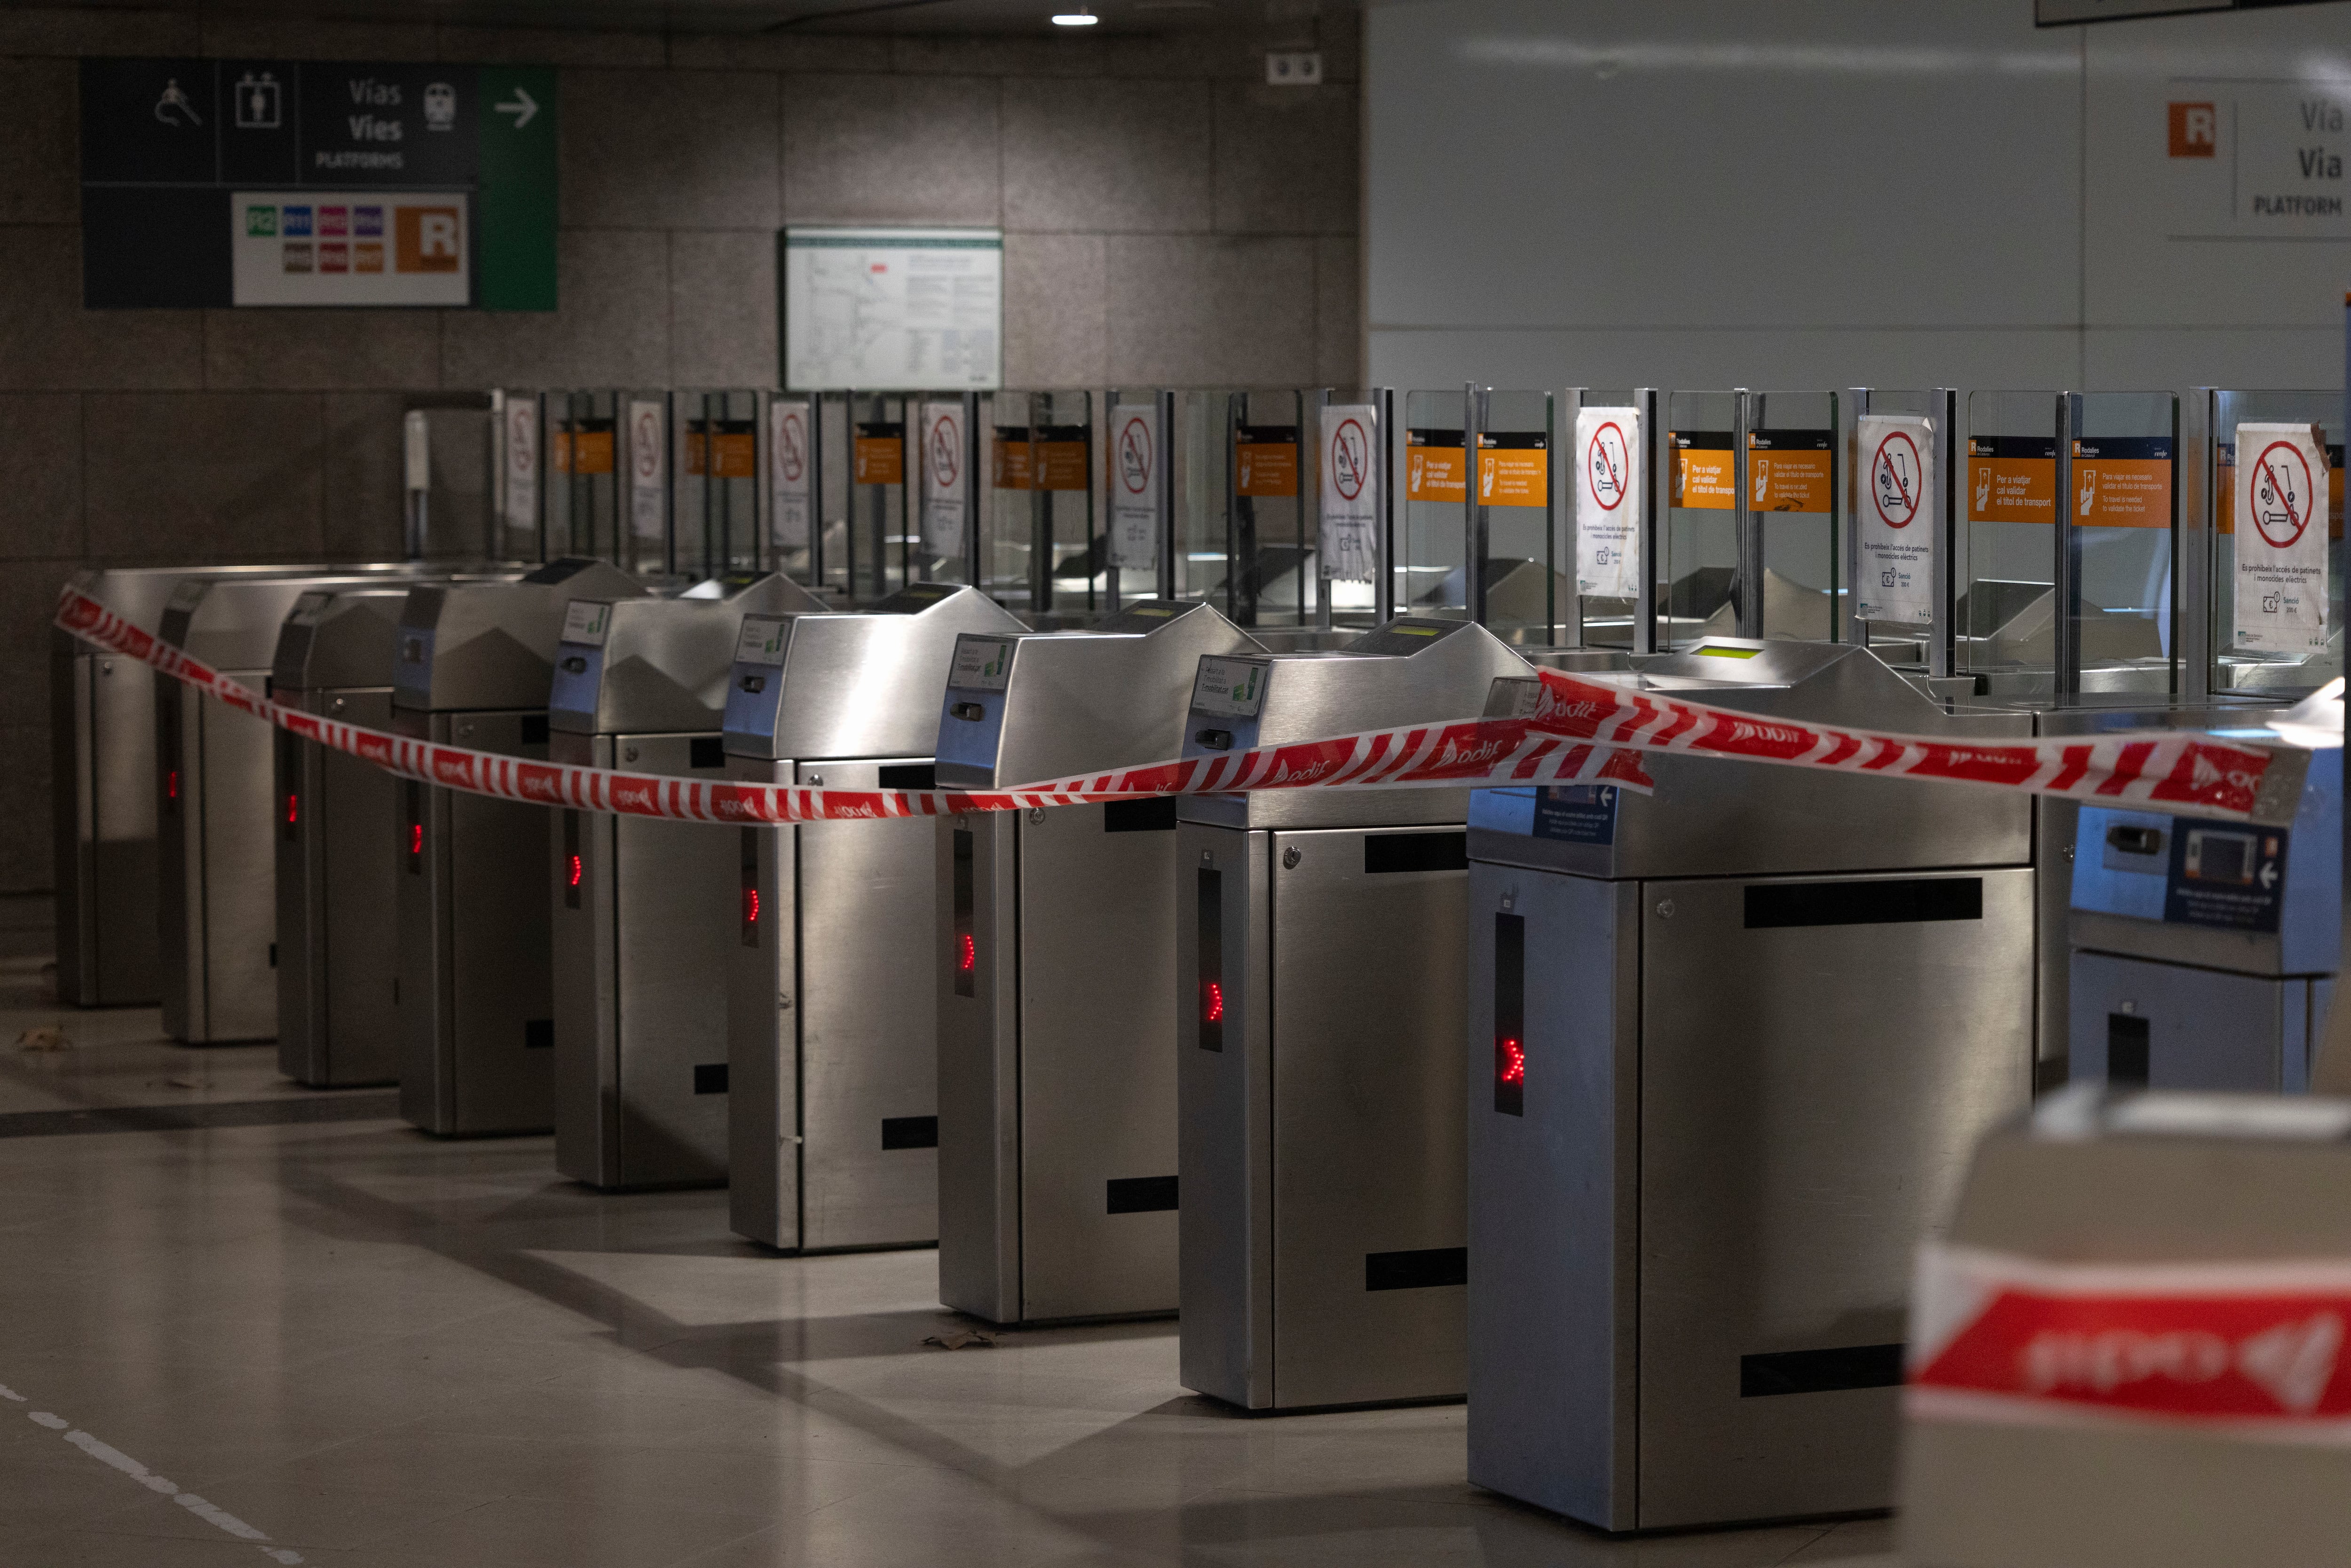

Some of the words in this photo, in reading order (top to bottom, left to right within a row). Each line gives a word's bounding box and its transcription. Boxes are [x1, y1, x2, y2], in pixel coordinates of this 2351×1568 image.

[349, 115, 403, 142] Vies
[315, 150, 403, 168] PLATFORMS
[2254, 196, 2343, 216] PLATFORM
[420, 214, 458, 257] R
[1971, 442, 1976, 452] R
[2075, 443, 2081, 453] R
[2154, 449, 2168, 459] renfe
[1692, 465, 1701, 473] Per
[1706, 465, 1721, 475] viatjar
[1701, 475, 1717, 484] validar
[1996, 474, 2006, 484] Per
[2013, 475, 2031, 486] viatjar
[2114, 473, 2125, 482] viajar
[1692, 485, 1697, 493] el
[1708, 485, 1714, 494] de
[1715, 486, 1735, 496] transpo
[1996, 486, 2005, 495] cal
[2006, 486, 2026, 495] validar
[1996, 496, 2002, 505] el
[2003, 496, 2014, 506] títol
[2015, 496, 2023, 506] de
[2024, 497, 2051, 509] transport
[2248, 564, 2272, 573] prohibeix
[2300, 567, 2321, 575] patinets
[1202, 683, 1229, 693] T-mobilitat.cat
[1457, 739, 1503, 763] adif
[1292, 759, 1330, 782] adif
